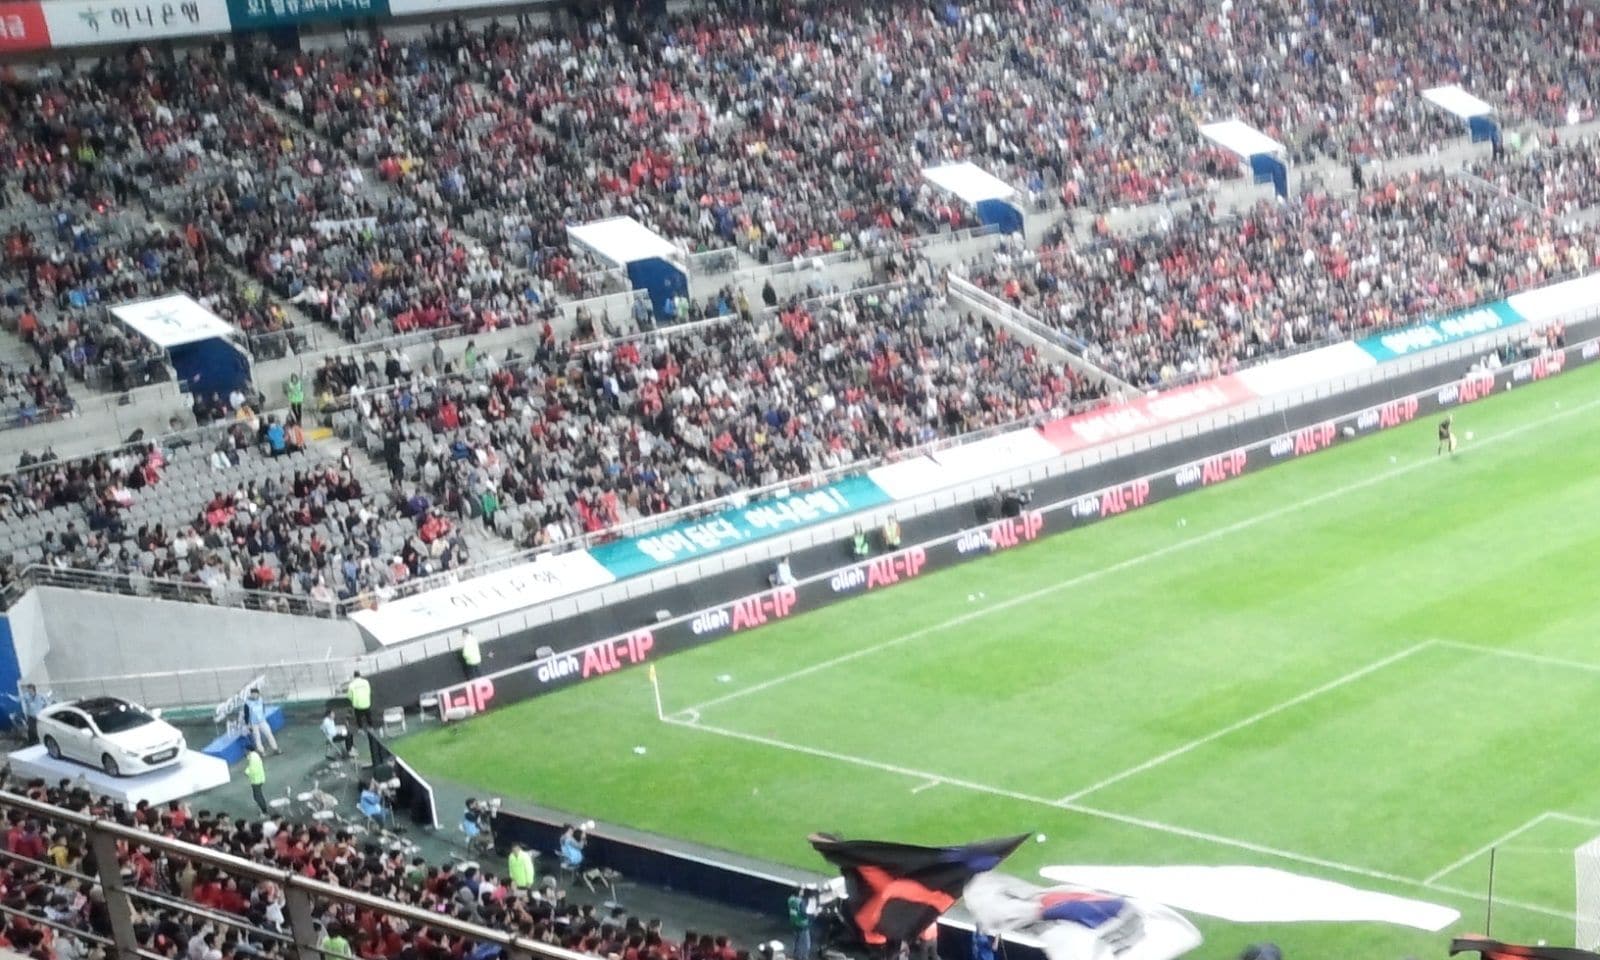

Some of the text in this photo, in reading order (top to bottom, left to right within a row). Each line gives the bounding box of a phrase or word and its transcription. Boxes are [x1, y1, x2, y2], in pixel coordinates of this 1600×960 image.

[1202, 449, 1247, 486] ALL-IP
[1101, 479, 1150, 518] ALL-IP
[831, 547, 927, 592] olleh ALL-IP
[692, 587, 797, 635] olleh ALL-IP
[538, 629, 655, 683] olleh ALL-IP
